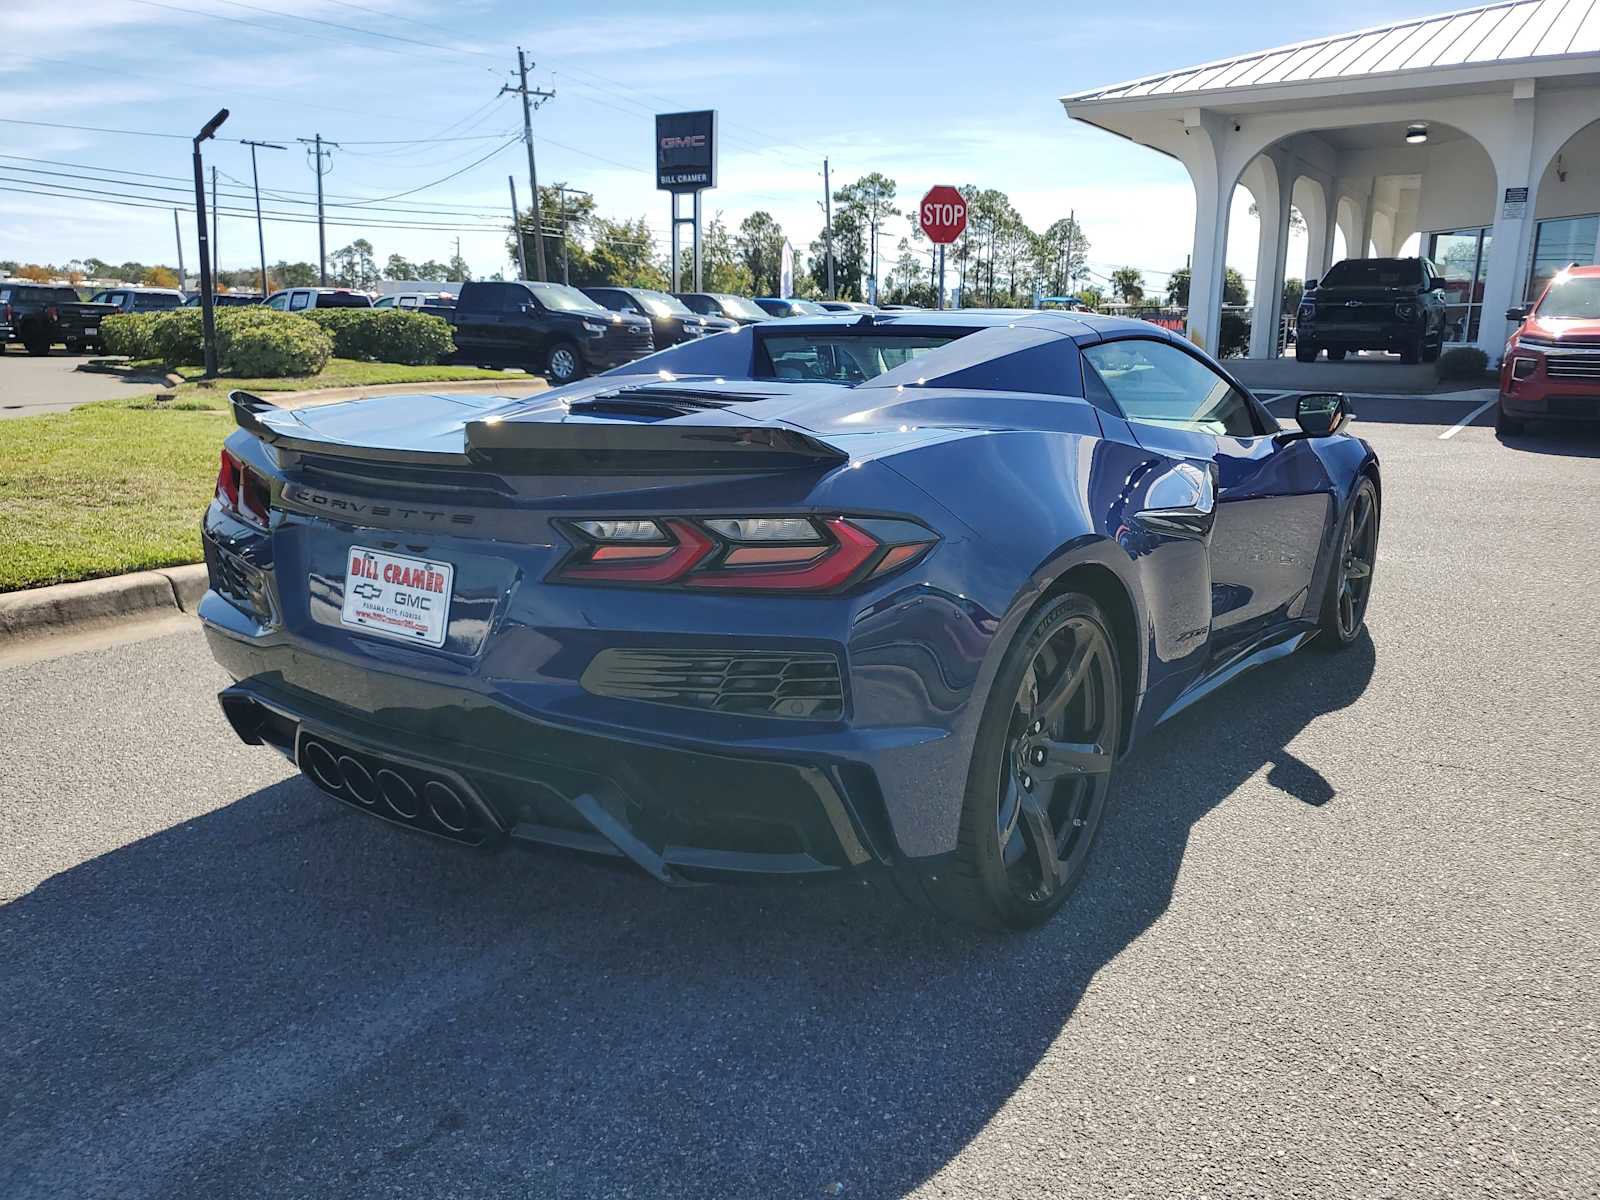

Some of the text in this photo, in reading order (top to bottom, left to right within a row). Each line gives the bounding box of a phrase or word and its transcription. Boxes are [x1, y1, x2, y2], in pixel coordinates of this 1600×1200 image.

[660, 135, 705, 149] GMC
[660, 173, 707, 185] BILL CRAMER
[922, 203, 965, 226] STOP
[295, 490, 476, 525] CORVETTE
[351, 556, 445, 594] BILL CRAMER
[394, 591, 432, 611] GMC
